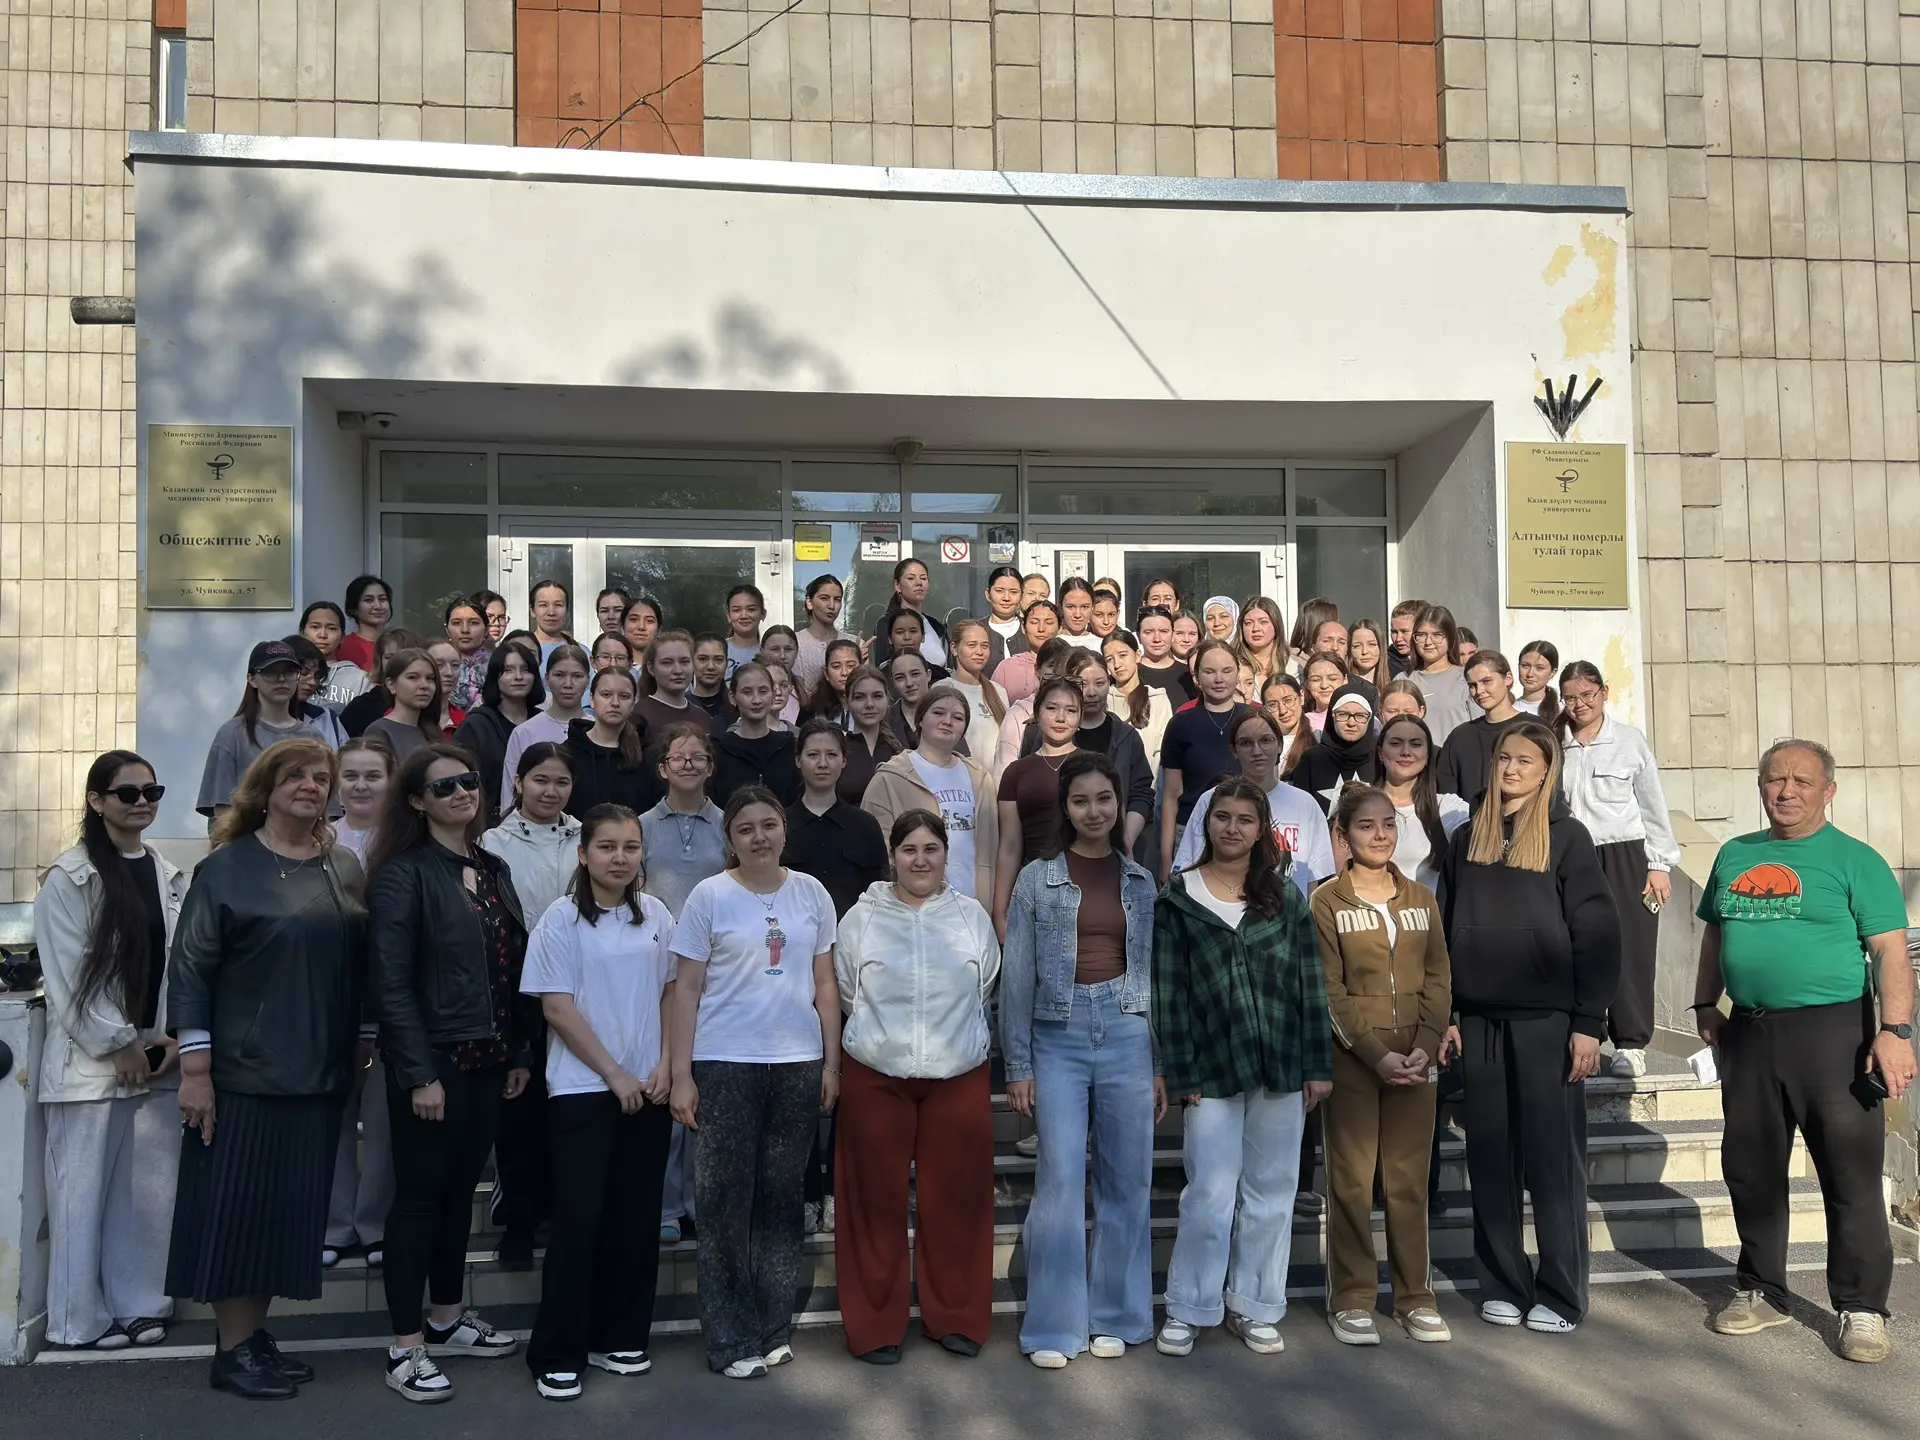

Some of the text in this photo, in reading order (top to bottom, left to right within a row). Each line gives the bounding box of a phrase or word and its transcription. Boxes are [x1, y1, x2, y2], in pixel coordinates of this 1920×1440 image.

[163, 431, 214, 439] Министерство
[223, 440, 262, 448] Федерации
[163, 485, 277, 496] Казанский государственный
[168, 495, 275, 504] медицинский университет
[1574, 498, 1607, 506] медицина
[1543, 506, 1591, 514] университеты
[159, 533, 281, 547] Общежитие №6
[1512, 531, 1624, 544] Алтынчы номерлы
[1533, 545, 1603, 558] тулай торак
[180, 587, 193, 596] ул.
[196, 586, 235, 595] Чуйкова,
[1530, 588, 1555, 596] Чуйков
[933, 789, 971, 803] KITTEN
